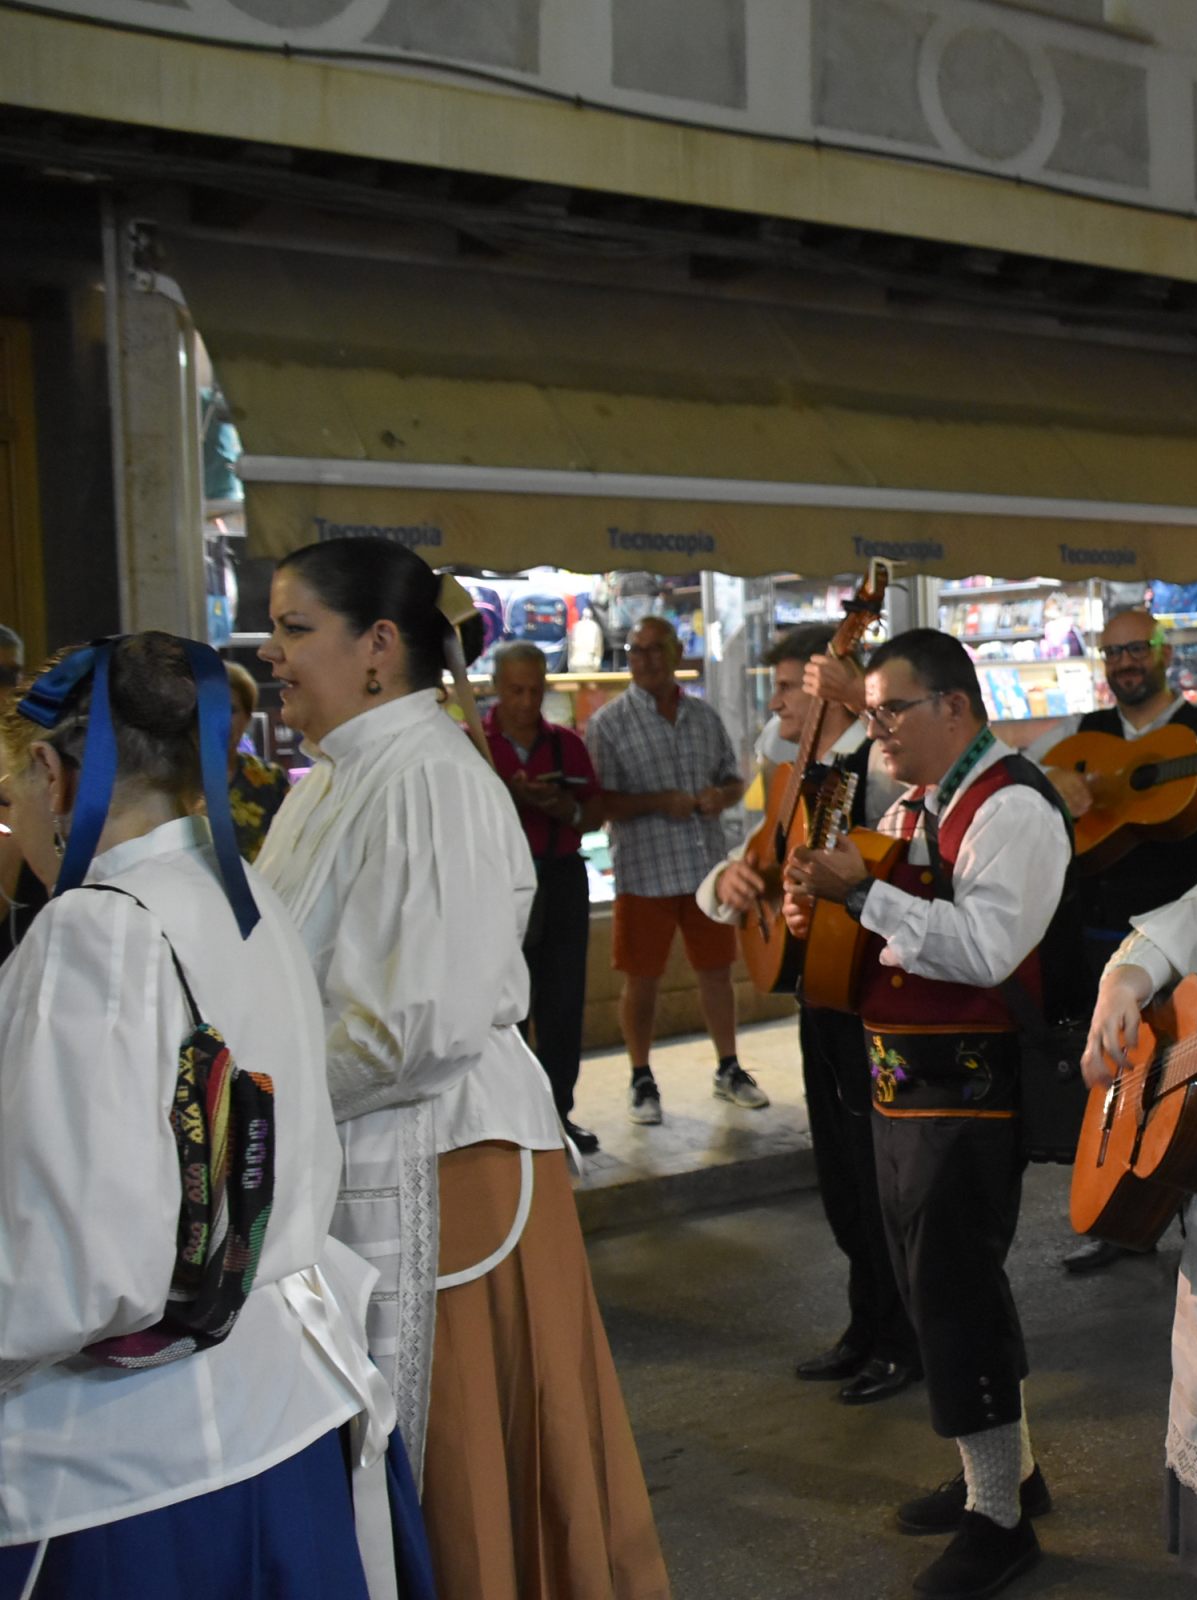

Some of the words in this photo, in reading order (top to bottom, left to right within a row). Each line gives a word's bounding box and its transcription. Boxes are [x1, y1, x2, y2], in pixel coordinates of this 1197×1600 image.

[607, 527, 714, 557] Tecnocopia
[852, 534, 944, 562] Tecnocopia
[1059, 543, 1137, 568] Tecnocopia
